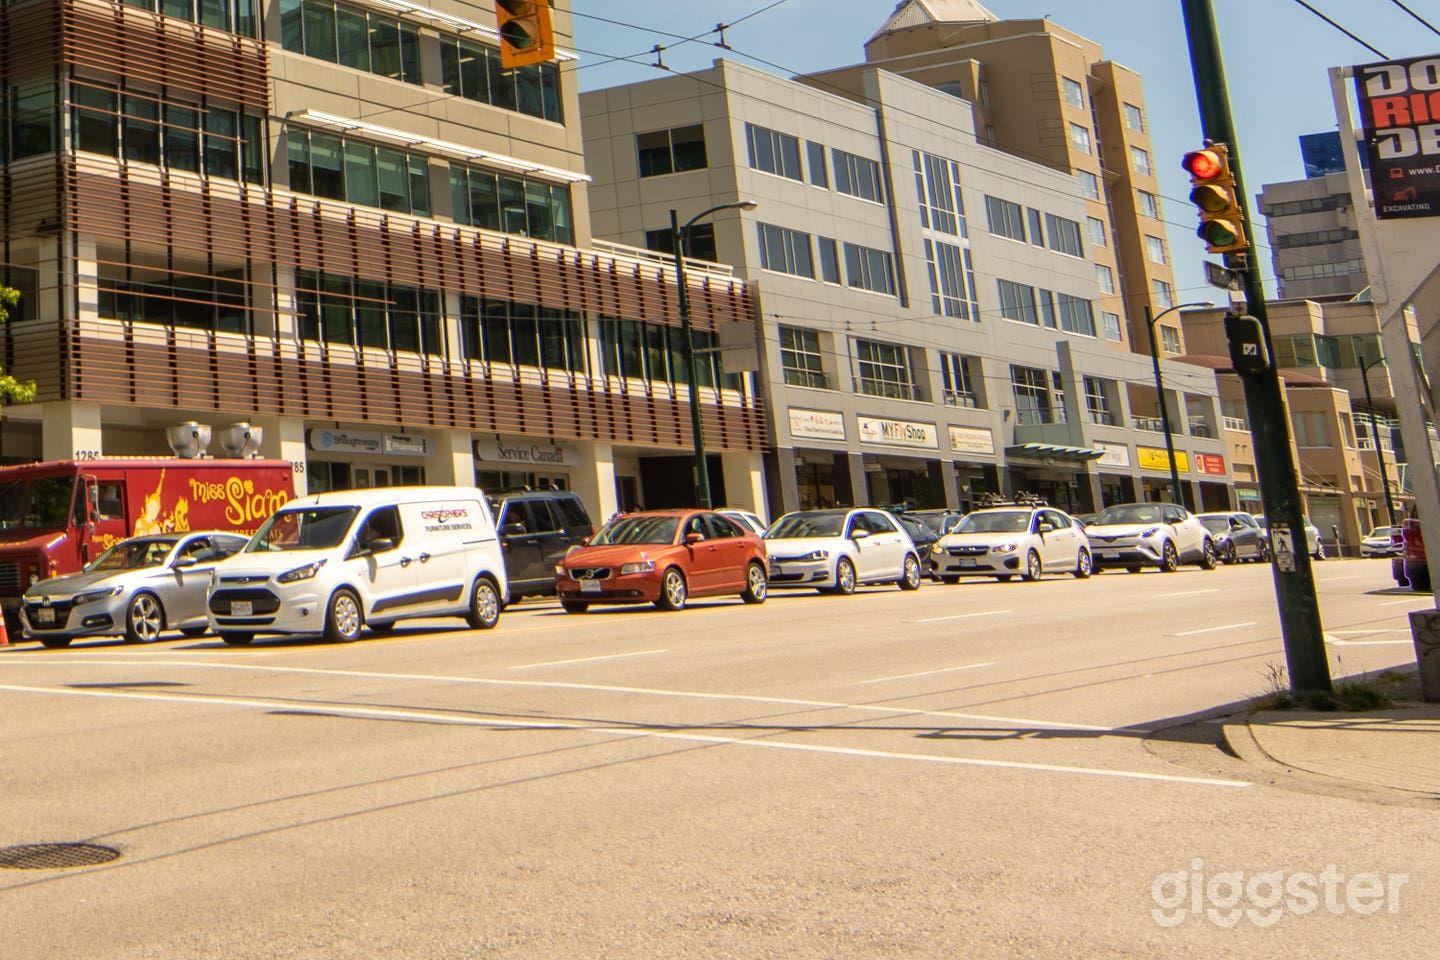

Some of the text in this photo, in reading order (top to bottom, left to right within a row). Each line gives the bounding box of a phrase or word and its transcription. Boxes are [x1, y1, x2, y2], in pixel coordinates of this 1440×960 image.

[1371, 89, 1440, 129] RI
[1382, 202, 1430, 213] EXCAVATING
[498, 443, 564, 463] Service Canada
